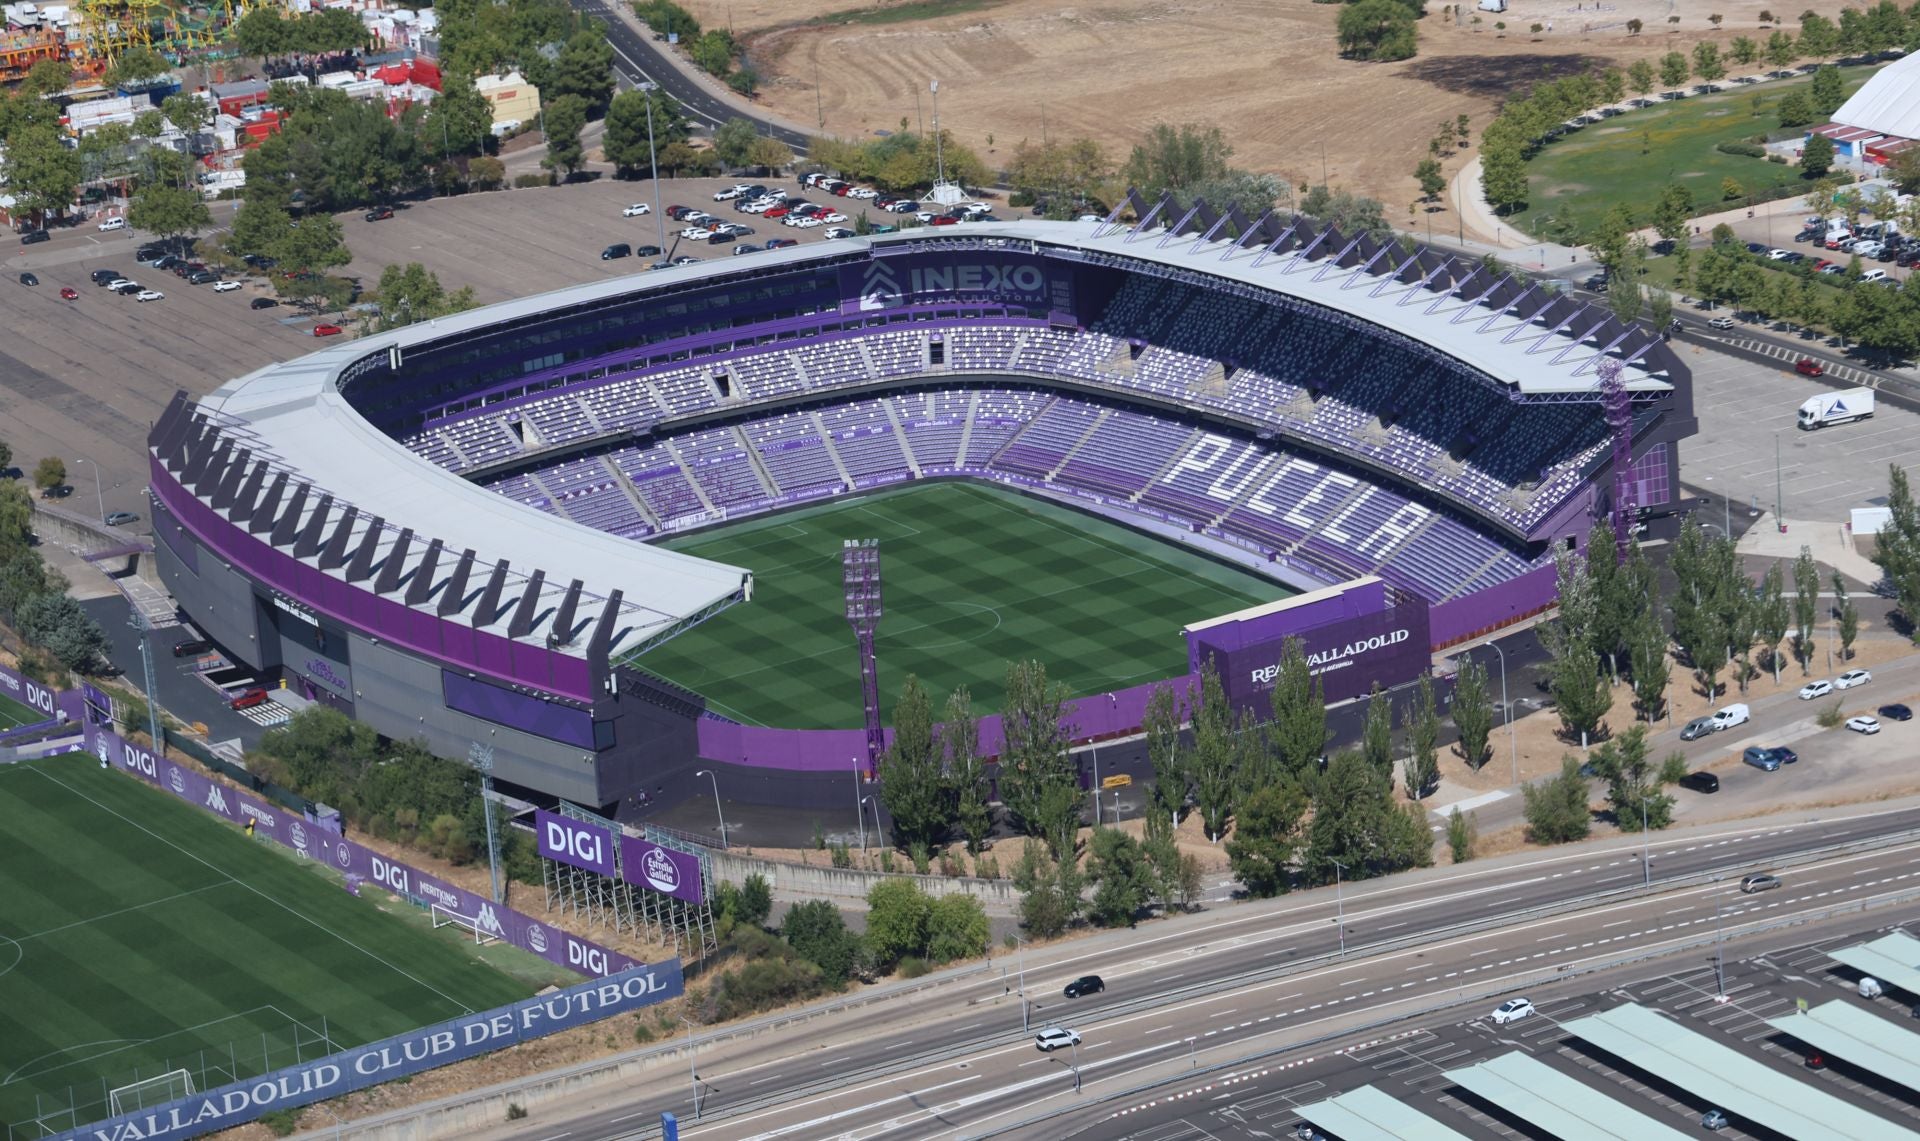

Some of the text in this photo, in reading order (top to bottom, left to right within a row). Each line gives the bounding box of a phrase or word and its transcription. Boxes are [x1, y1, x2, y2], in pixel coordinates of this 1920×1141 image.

[911, 265, 1043, 292] INEXO
[1162, 433, 1431, 560] PUCELA
[26, 682, 54, 714] DIGI
[125, 744, 157, 778] DIGI
[547, 821, 602, 865] DIGI
[372, 857, 409, 892] DIGI
[648, 857, 673, 874] Estrella
[650, 867, 673, 883] Galicia
[420, 880, 458, 908] MERITKING
[568, 939, 608, 977] DIGI
[94, 973, 668, 1141] VALLADOLID CLUB DE FÚTBOL
